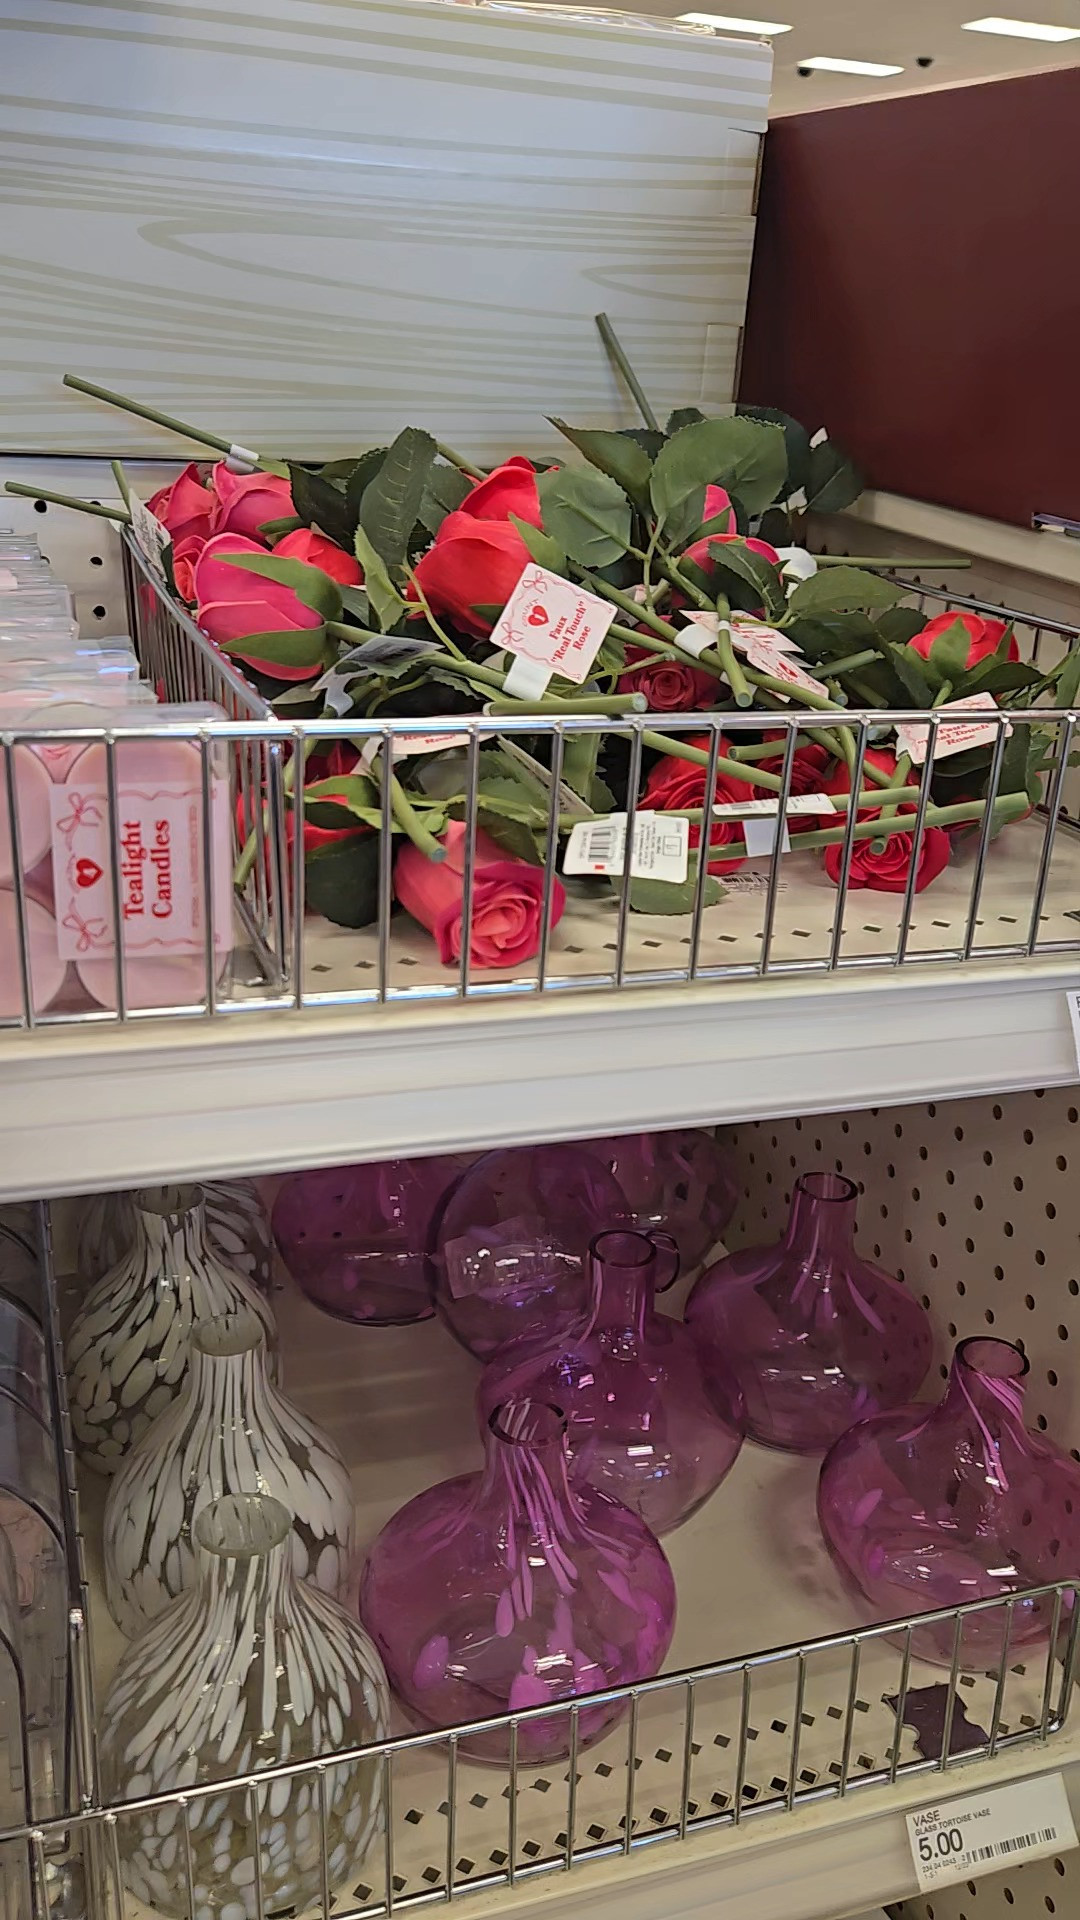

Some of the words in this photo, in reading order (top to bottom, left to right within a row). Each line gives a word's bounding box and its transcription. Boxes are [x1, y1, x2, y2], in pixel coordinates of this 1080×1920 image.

[549, 616, 568, 640] Faux
[551, 636, 571, 663] "Real
[564, 601, 587, 636] Touch"
[572, 625, 591, 650] Rose
[121, 821, 147, 919] Tealight
[151, 820, 172, 918] Candles
[912, 1809, 940, 1827] VASE
[915, 1823, 937, 1836] GLASS
[938, 1813, 973, 1830] TORTOISE
[973, 1808, 991, 1818] VASE
[918, 1828, 963, 1861] 5.00
